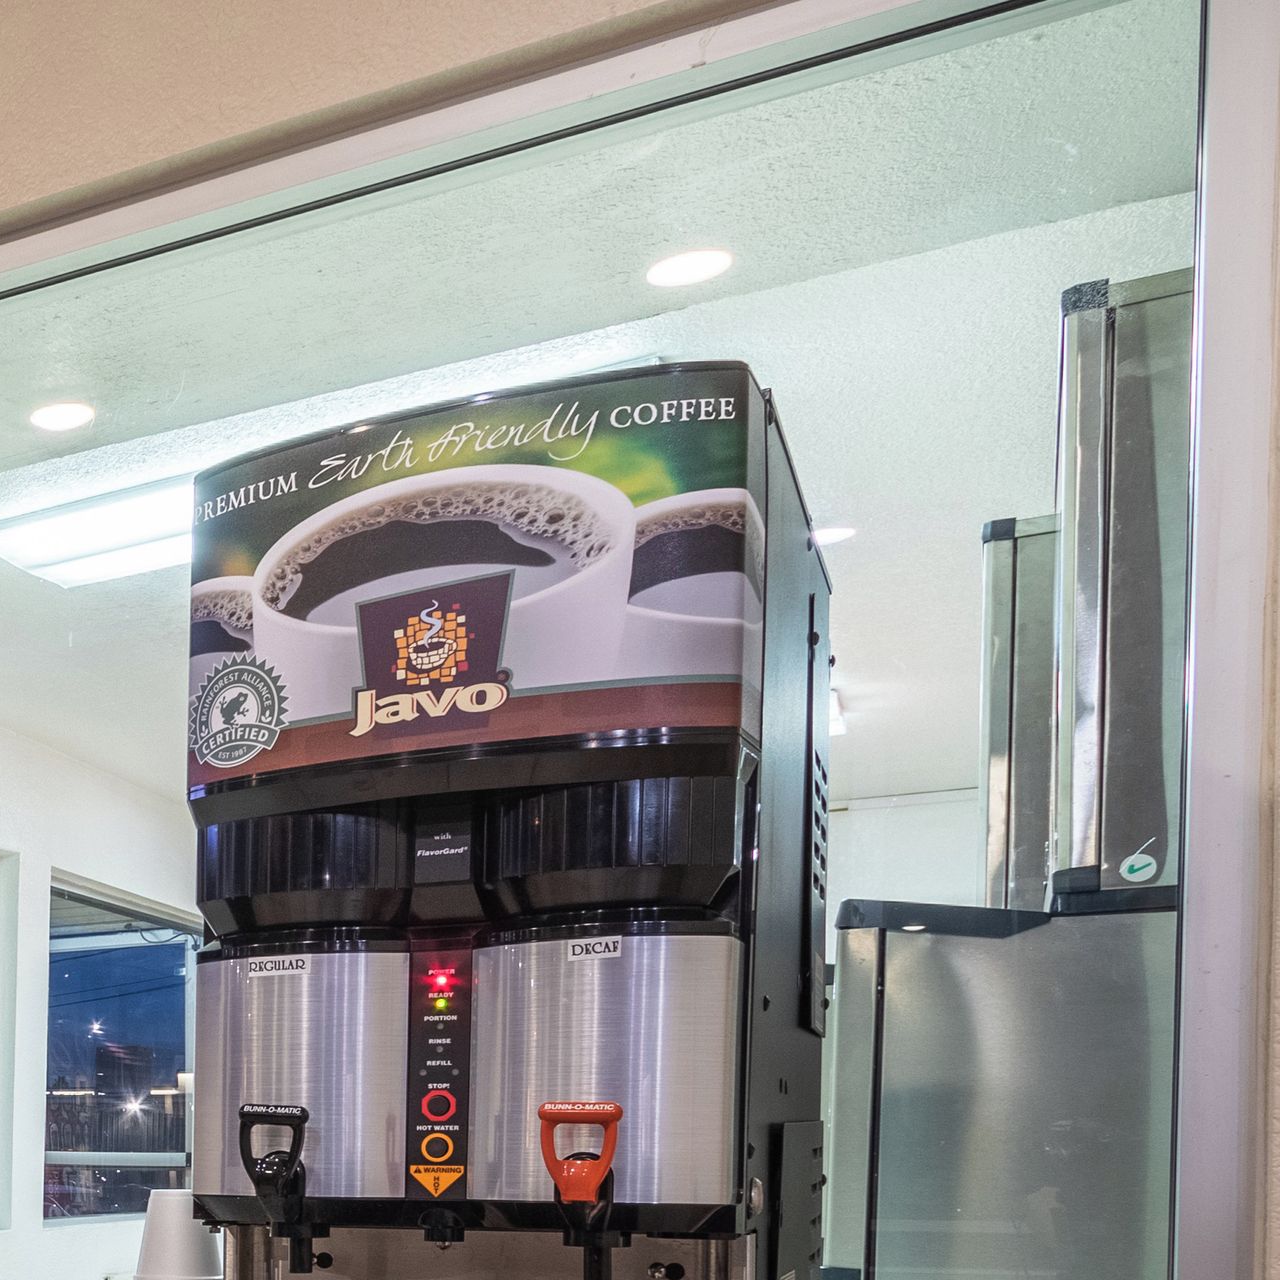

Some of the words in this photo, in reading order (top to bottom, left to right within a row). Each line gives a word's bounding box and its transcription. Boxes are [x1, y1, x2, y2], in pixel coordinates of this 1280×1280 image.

[194, 471, 298, 526] PREMIUM
[308, 429, 419, 489] Earth
[609, 397, 736, 429] COFFEE
[200, 672, 239, 721] RAINFOREST
[241, 672, 272, 707] ALLIANCE
[348, 682, 508, 737] Javo
[202, 727, 269, 755] CERTIFIED
[433, 832, 452, 840] with
[571, 940, 620, 956] DECAF
[248, 958, 307, 973] REGULAR
[243, 1105, 302, 1114] BUNN-O-MATIC
[544, 1102, 615, 1111] BUNN-O-MATIC
